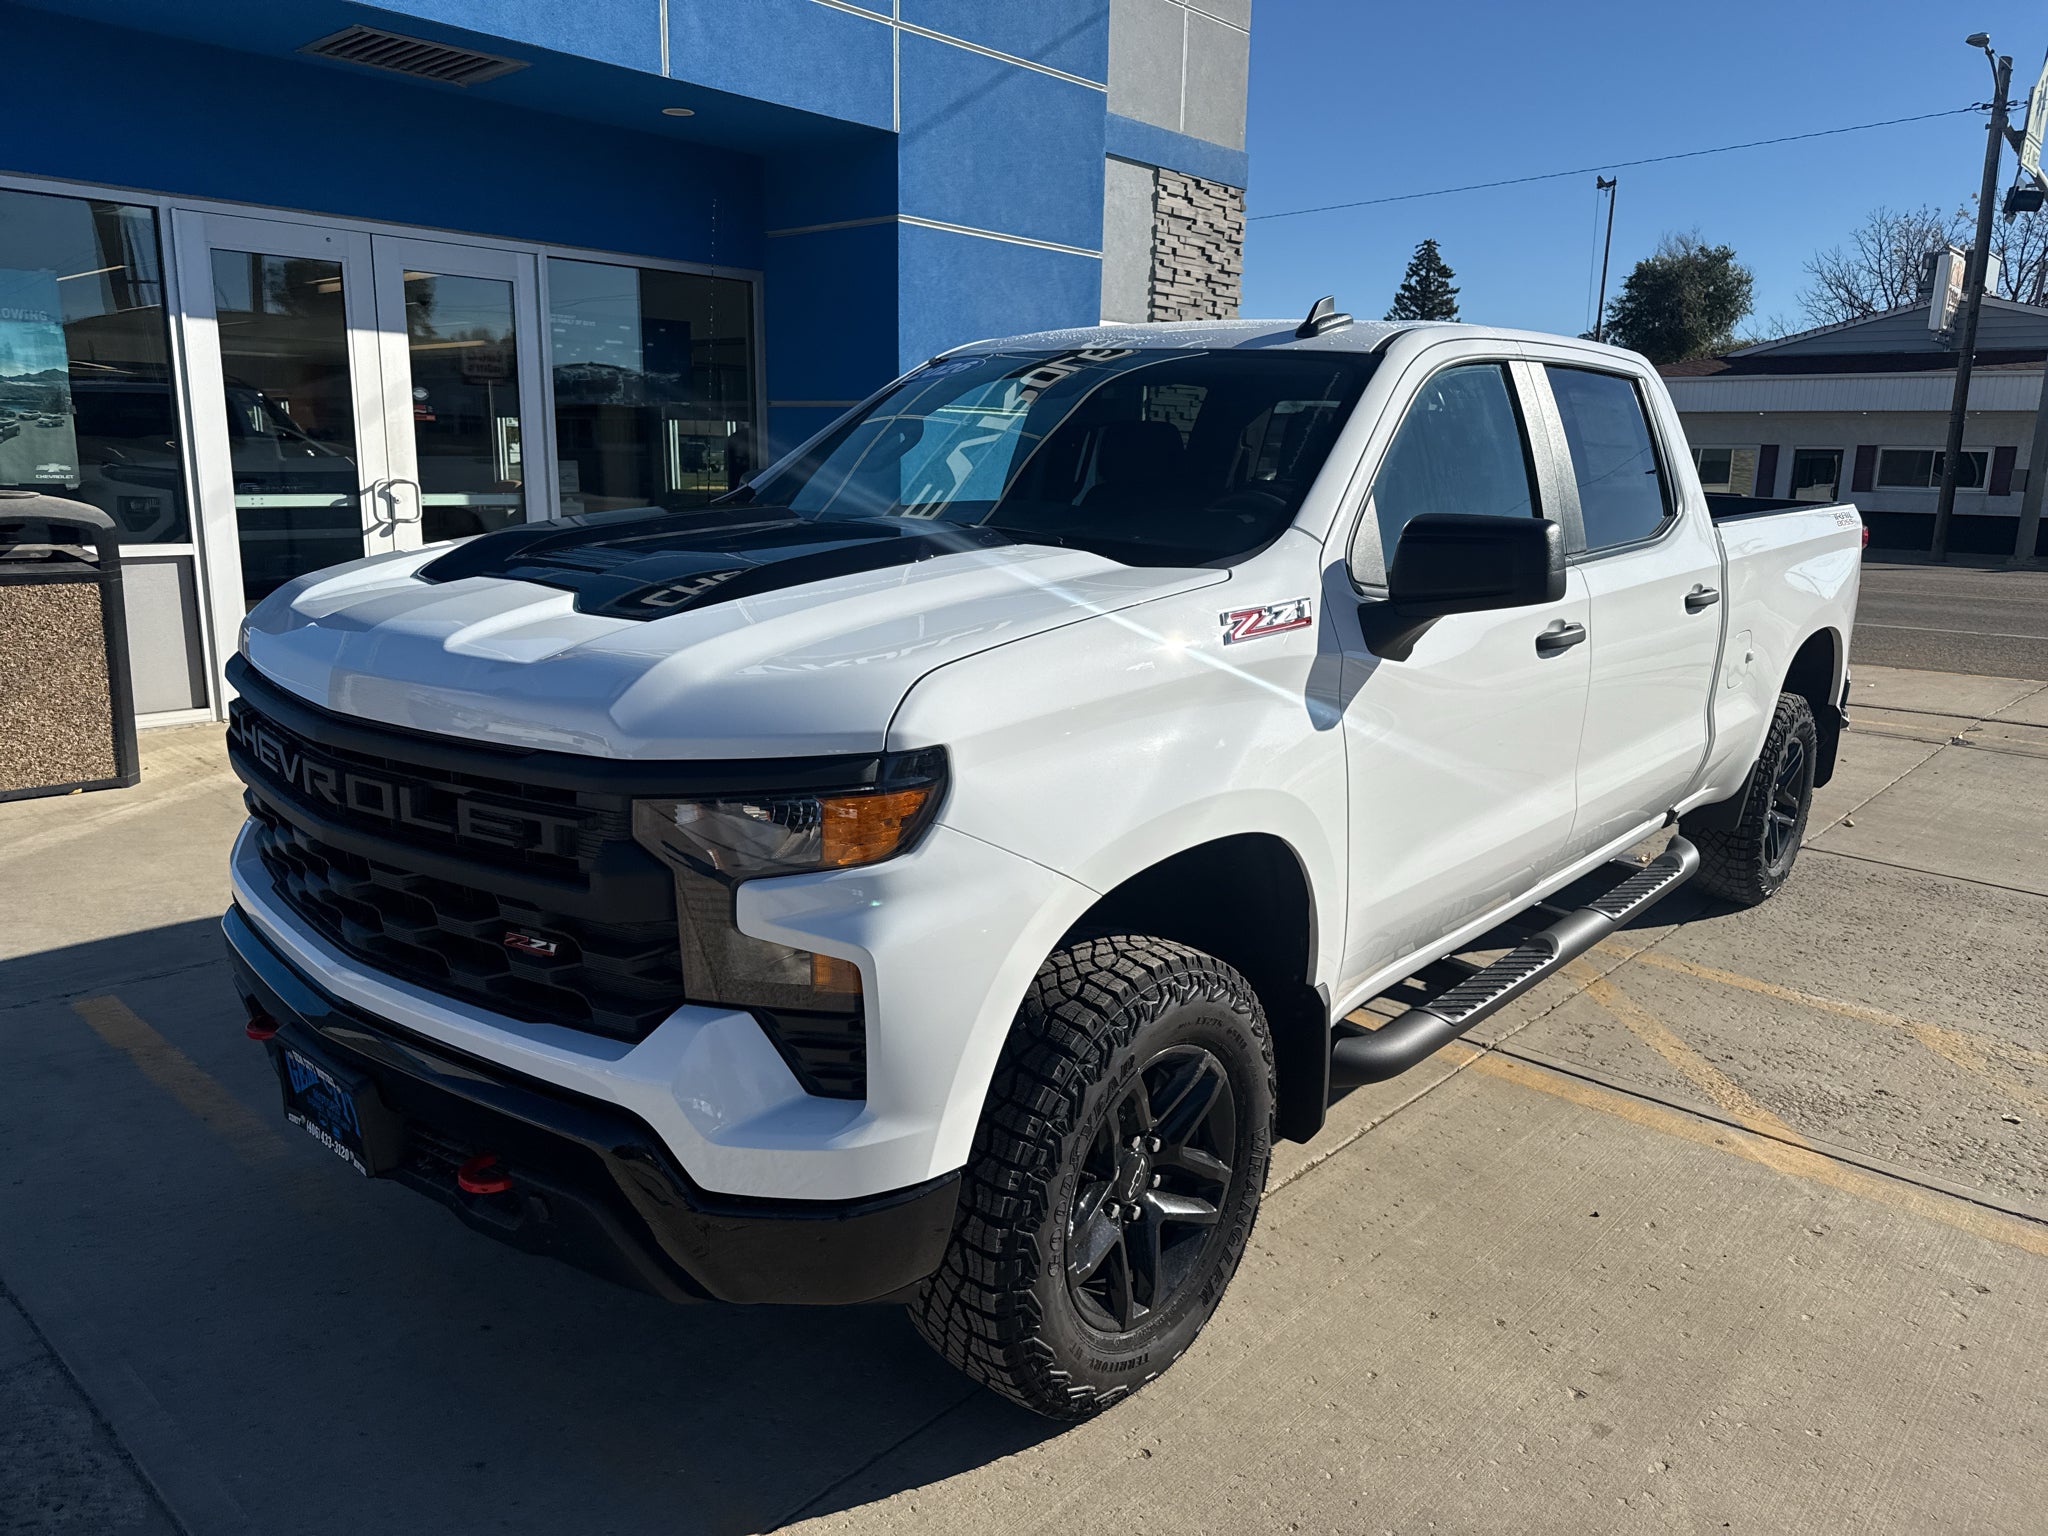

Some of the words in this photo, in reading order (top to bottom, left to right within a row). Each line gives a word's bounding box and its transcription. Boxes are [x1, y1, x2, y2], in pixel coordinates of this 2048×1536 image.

[1833, 511, 1854, 521] TRAIL
[1219, 598, 1312, 645] Z71
[229, 707, 597, 858] CHEVROLET
[504, 932, 557, 956] Z71
[1047, 1053, 1136, 1277] GOODYEAR
[1199, 1127, 1268, 1308] WRANGLER
[1088, 1352, 1149, 1373] TERRITORY
